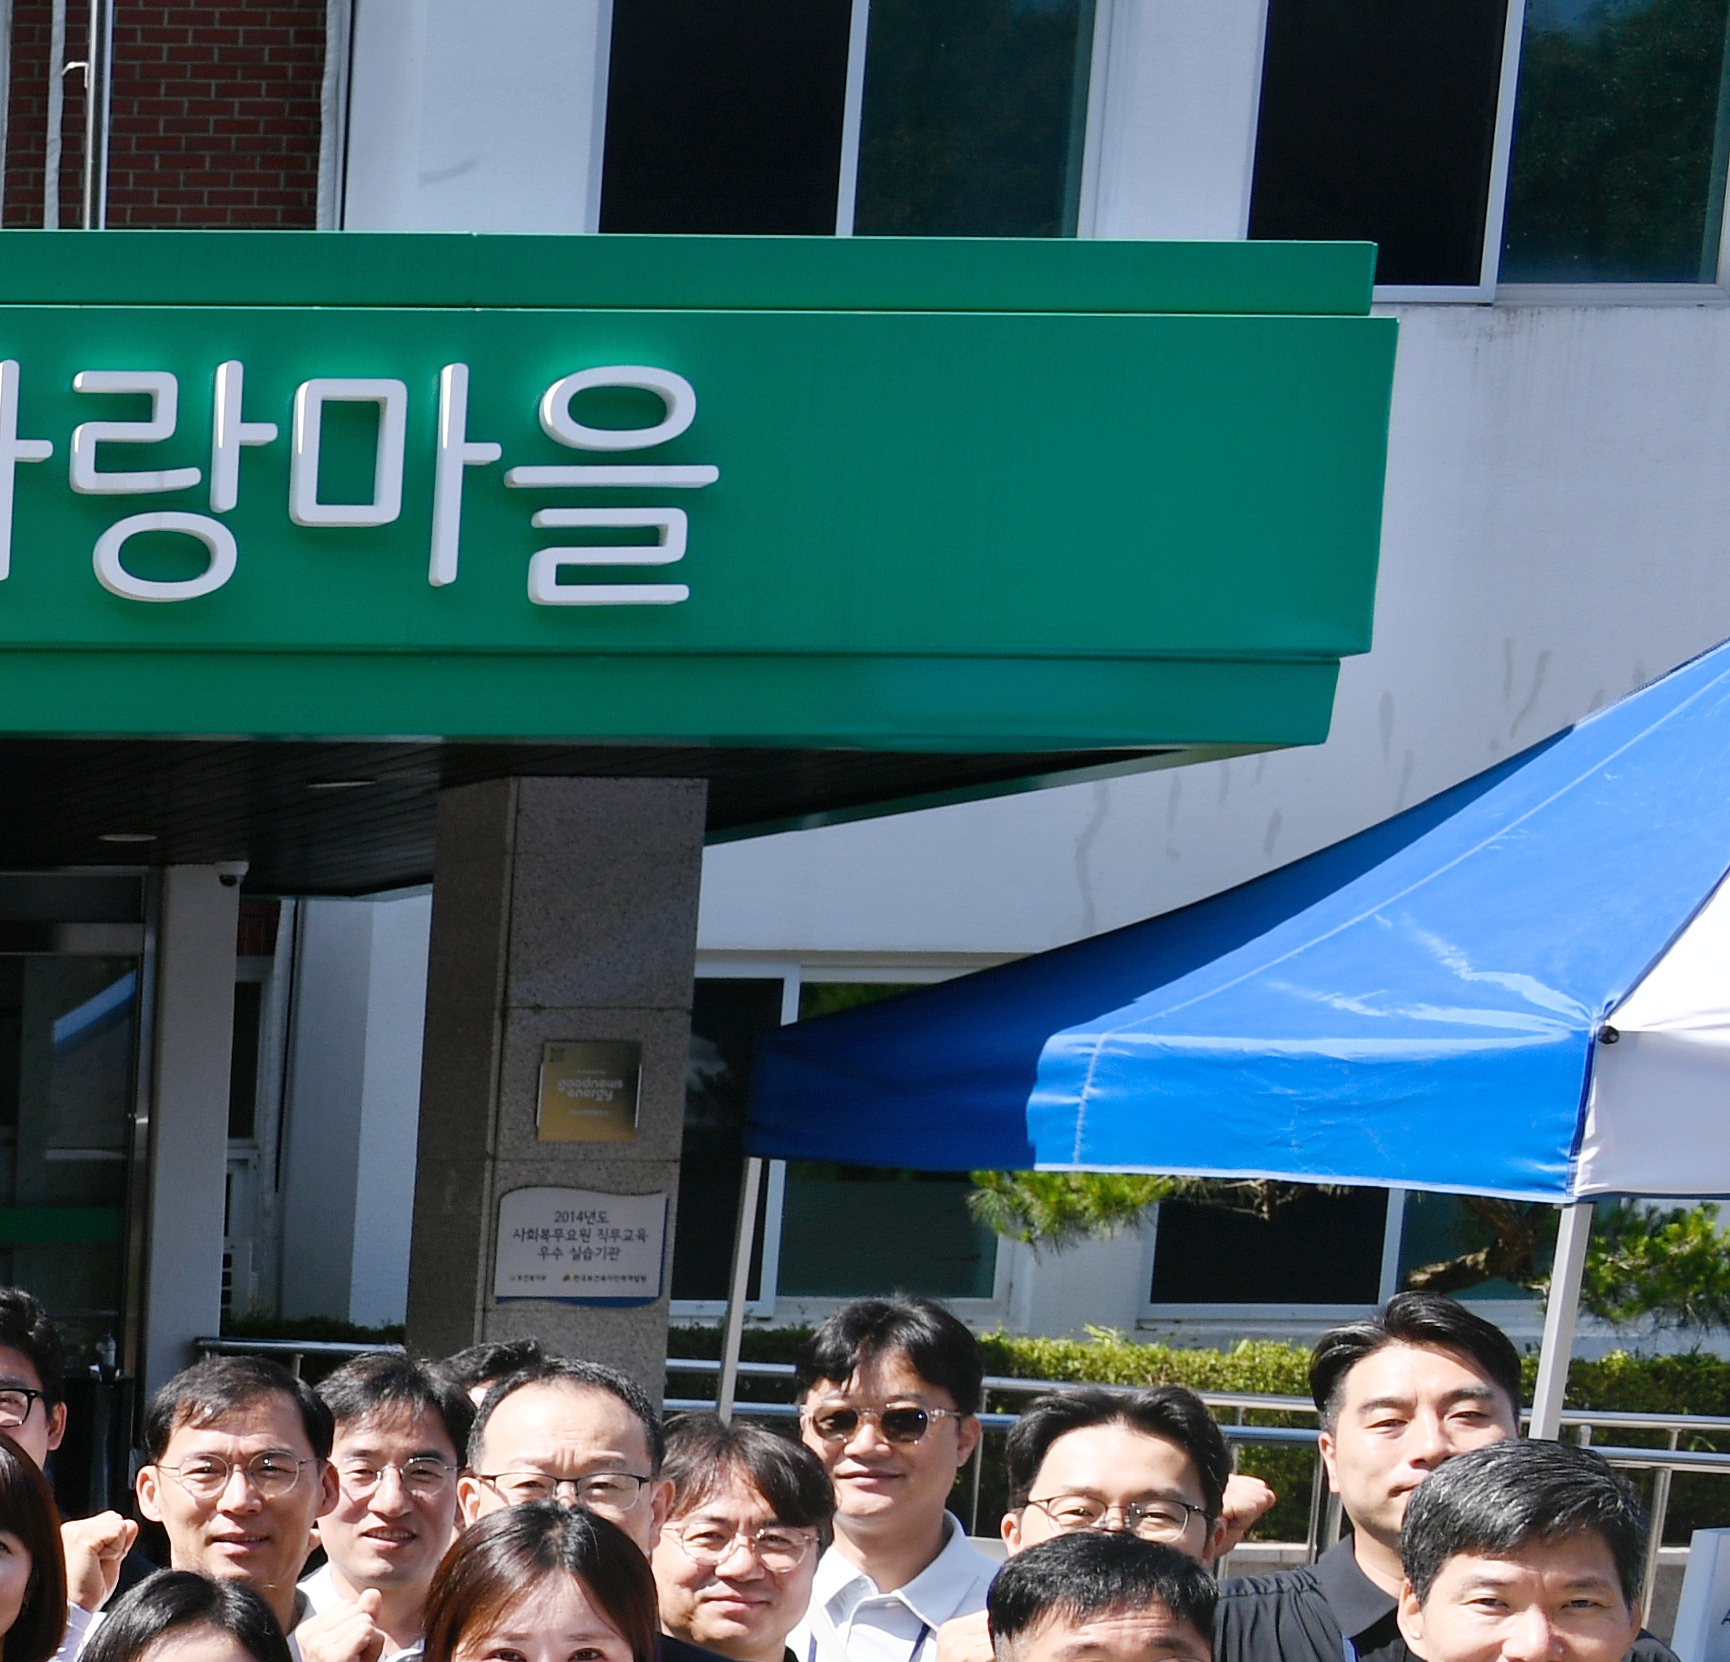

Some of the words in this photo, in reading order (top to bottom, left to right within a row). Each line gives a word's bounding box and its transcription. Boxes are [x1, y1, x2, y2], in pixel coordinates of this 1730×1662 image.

[554, 1210, 609, 1225] 2014년도
[513, 1228, 592, 1243] 사회복무요원
[597, 1228, 648, 1242] 직무교육
[538, 1247, 564, 1261] 우수
[569, 1247, 621, 1262] 실습기관
